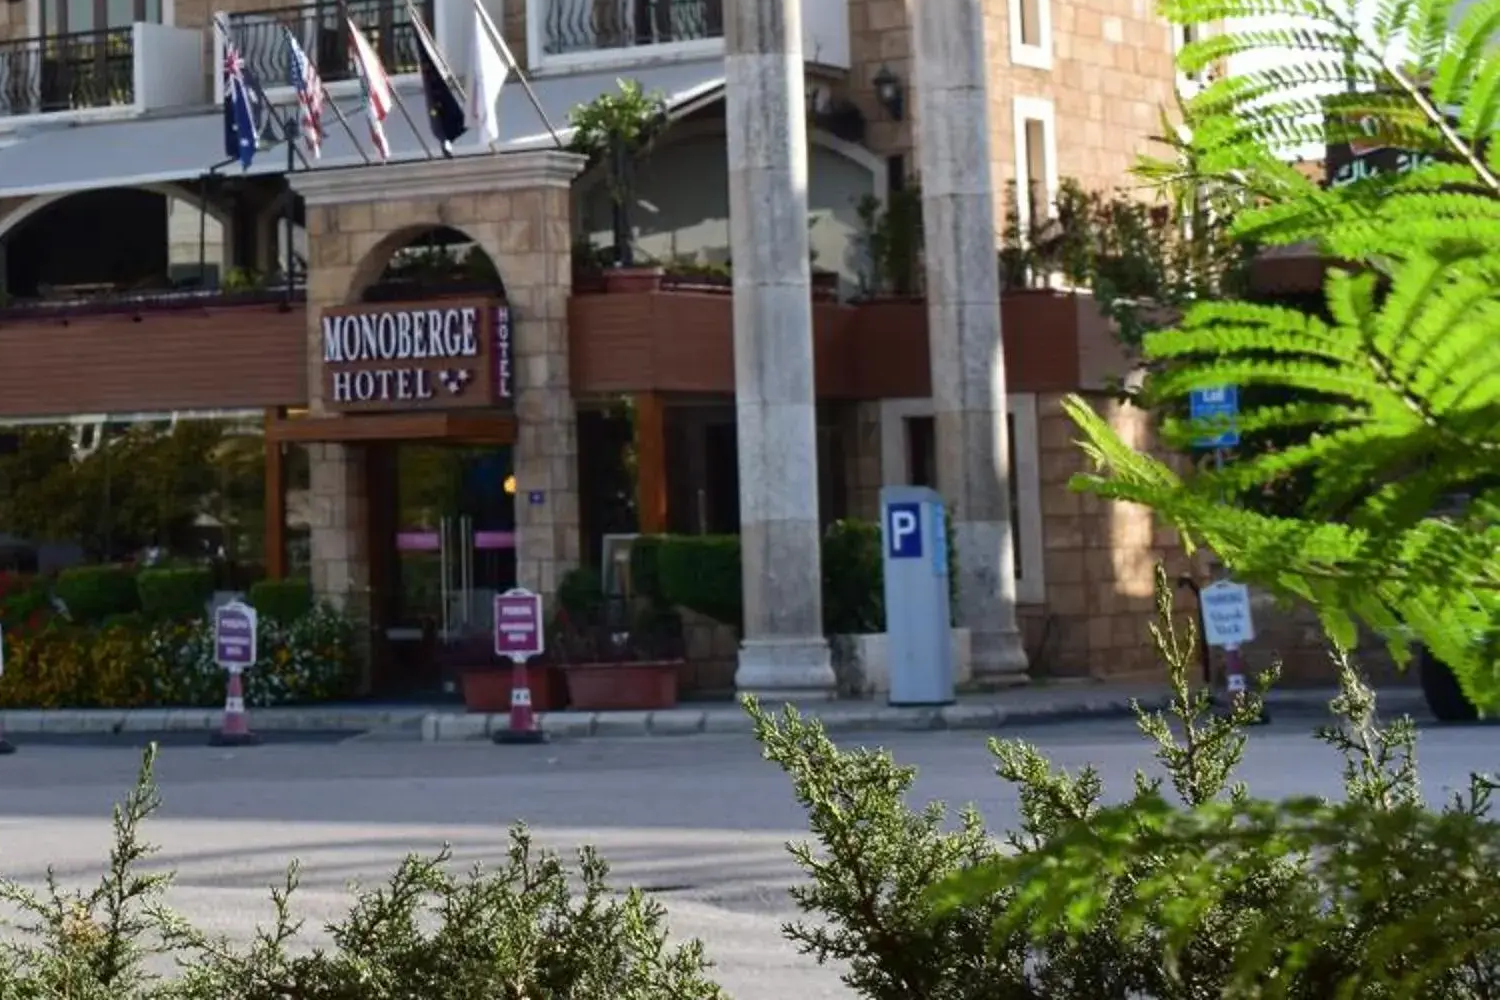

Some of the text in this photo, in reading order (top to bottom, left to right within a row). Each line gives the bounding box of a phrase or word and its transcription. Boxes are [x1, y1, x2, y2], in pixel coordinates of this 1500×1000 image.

[322, 307, 478, 363] MONOBERGE
[499, 306, 511, 398] HOTEL
[333, 368, 432, 402] HOTEL
[891, 509, 917, 551] P
